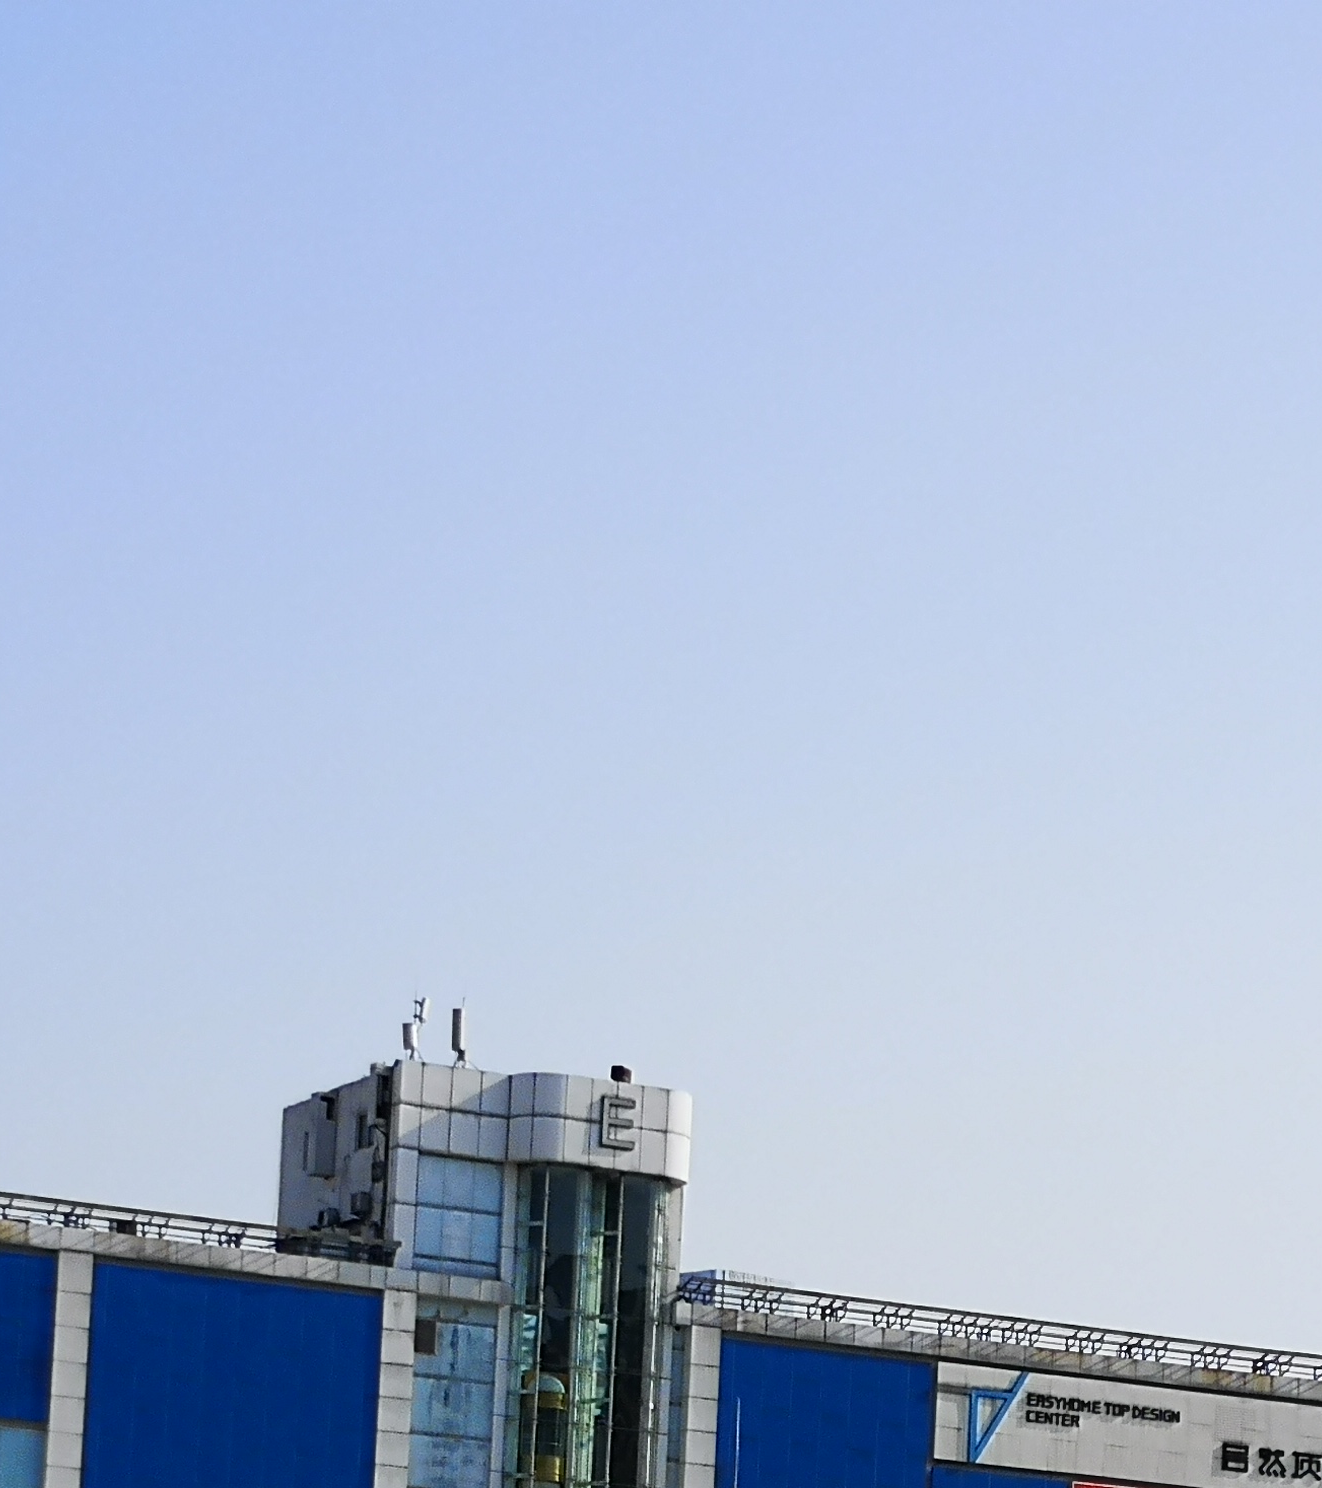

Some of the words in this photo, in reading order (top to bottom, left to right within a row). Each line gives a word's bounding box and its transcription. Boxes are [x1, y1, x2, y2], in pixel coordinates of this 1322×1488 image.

[600, 1094, 636, 1152] E
[1025, 1408, 1080, 1428] CENTER
[1026, 1392, 1101, 1415] EASYHOME
[1103, 1401, 1131, 1417] TOP
[1132, 1405, 1181, 1424] DESIGN
